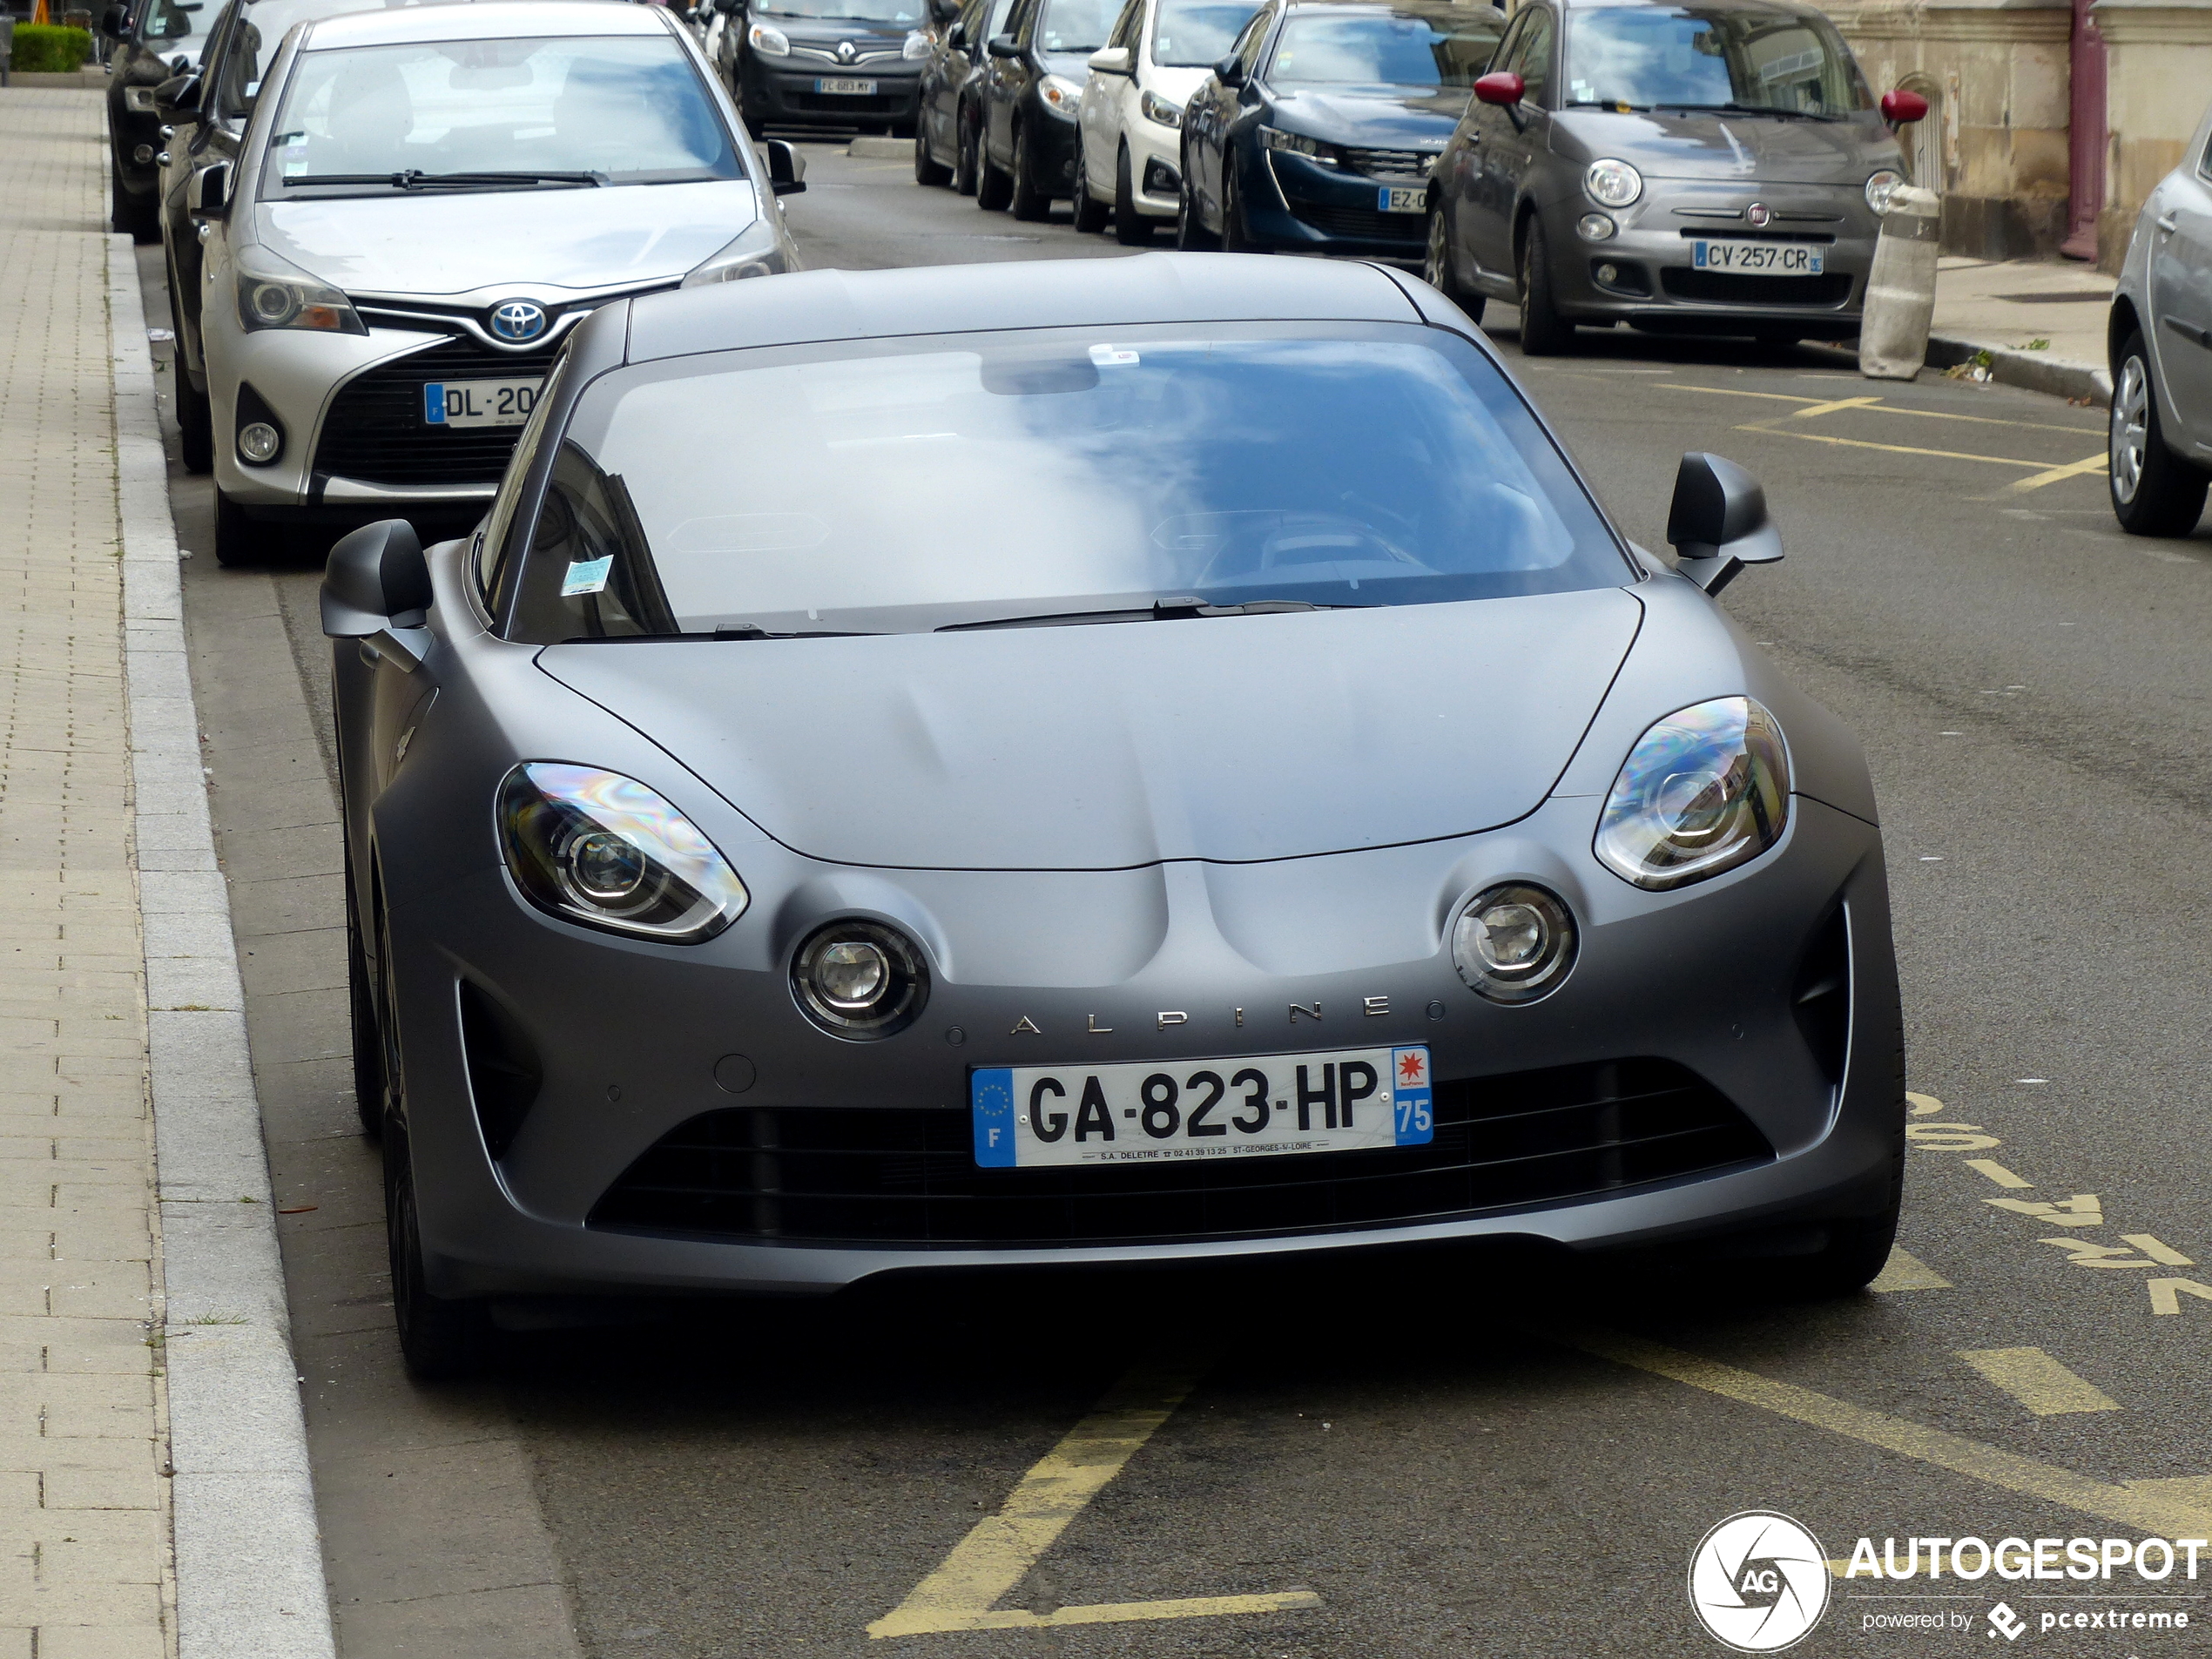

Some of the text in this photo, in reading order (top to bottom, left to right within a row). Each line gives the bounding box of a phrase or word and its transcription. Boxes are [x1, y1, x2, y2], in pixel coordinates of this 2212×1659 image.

[1709, 245, 1808, 270] CV-257-CR
[446, 386, 538, 416] DL-20
[1009, 995, 1390, 1035] ALPINE
[1028, 1060, 1379, 1143] GA-823-HP
[1396, 1098, 1431, 1133] 75
[988, 1128, 1001, 1148] F
[1121, 1150, 1159, 1159] DELETRE
